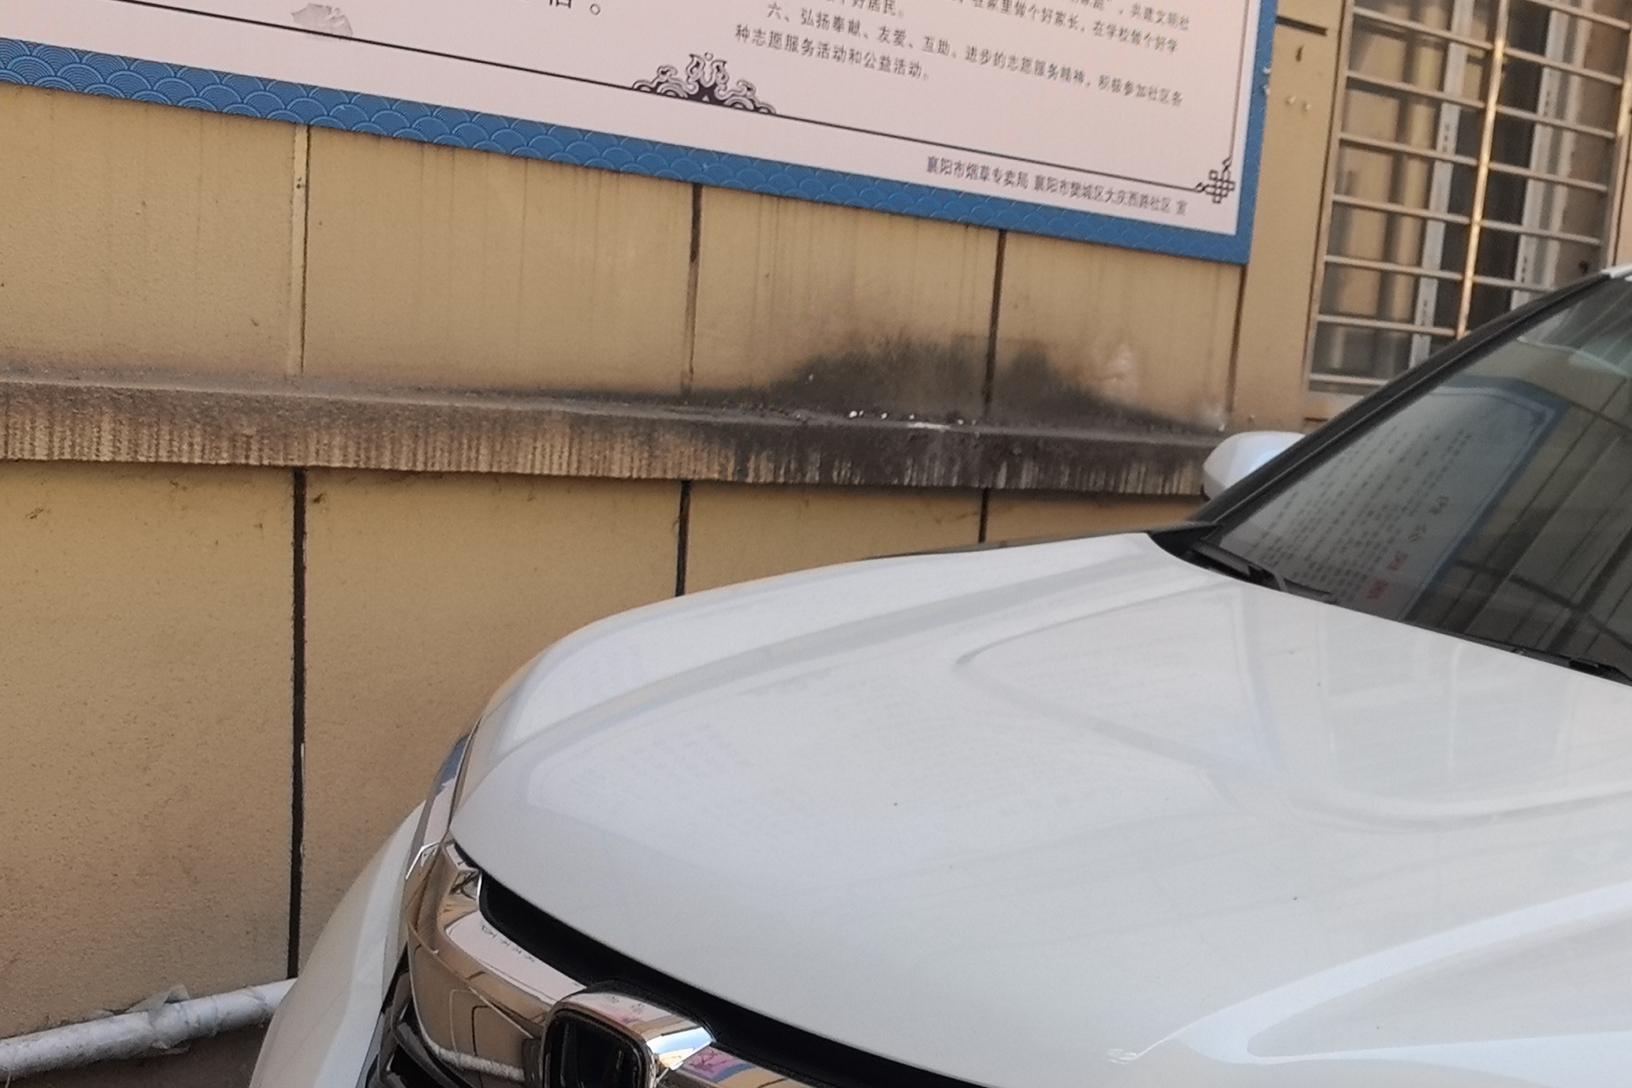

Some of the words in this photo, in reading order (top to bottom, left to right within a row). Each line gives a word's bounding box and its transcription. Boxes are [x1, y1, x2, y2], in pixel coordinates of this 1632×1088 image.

[734, 23, 930, 81] 种志愿服务活动和公益活动。
